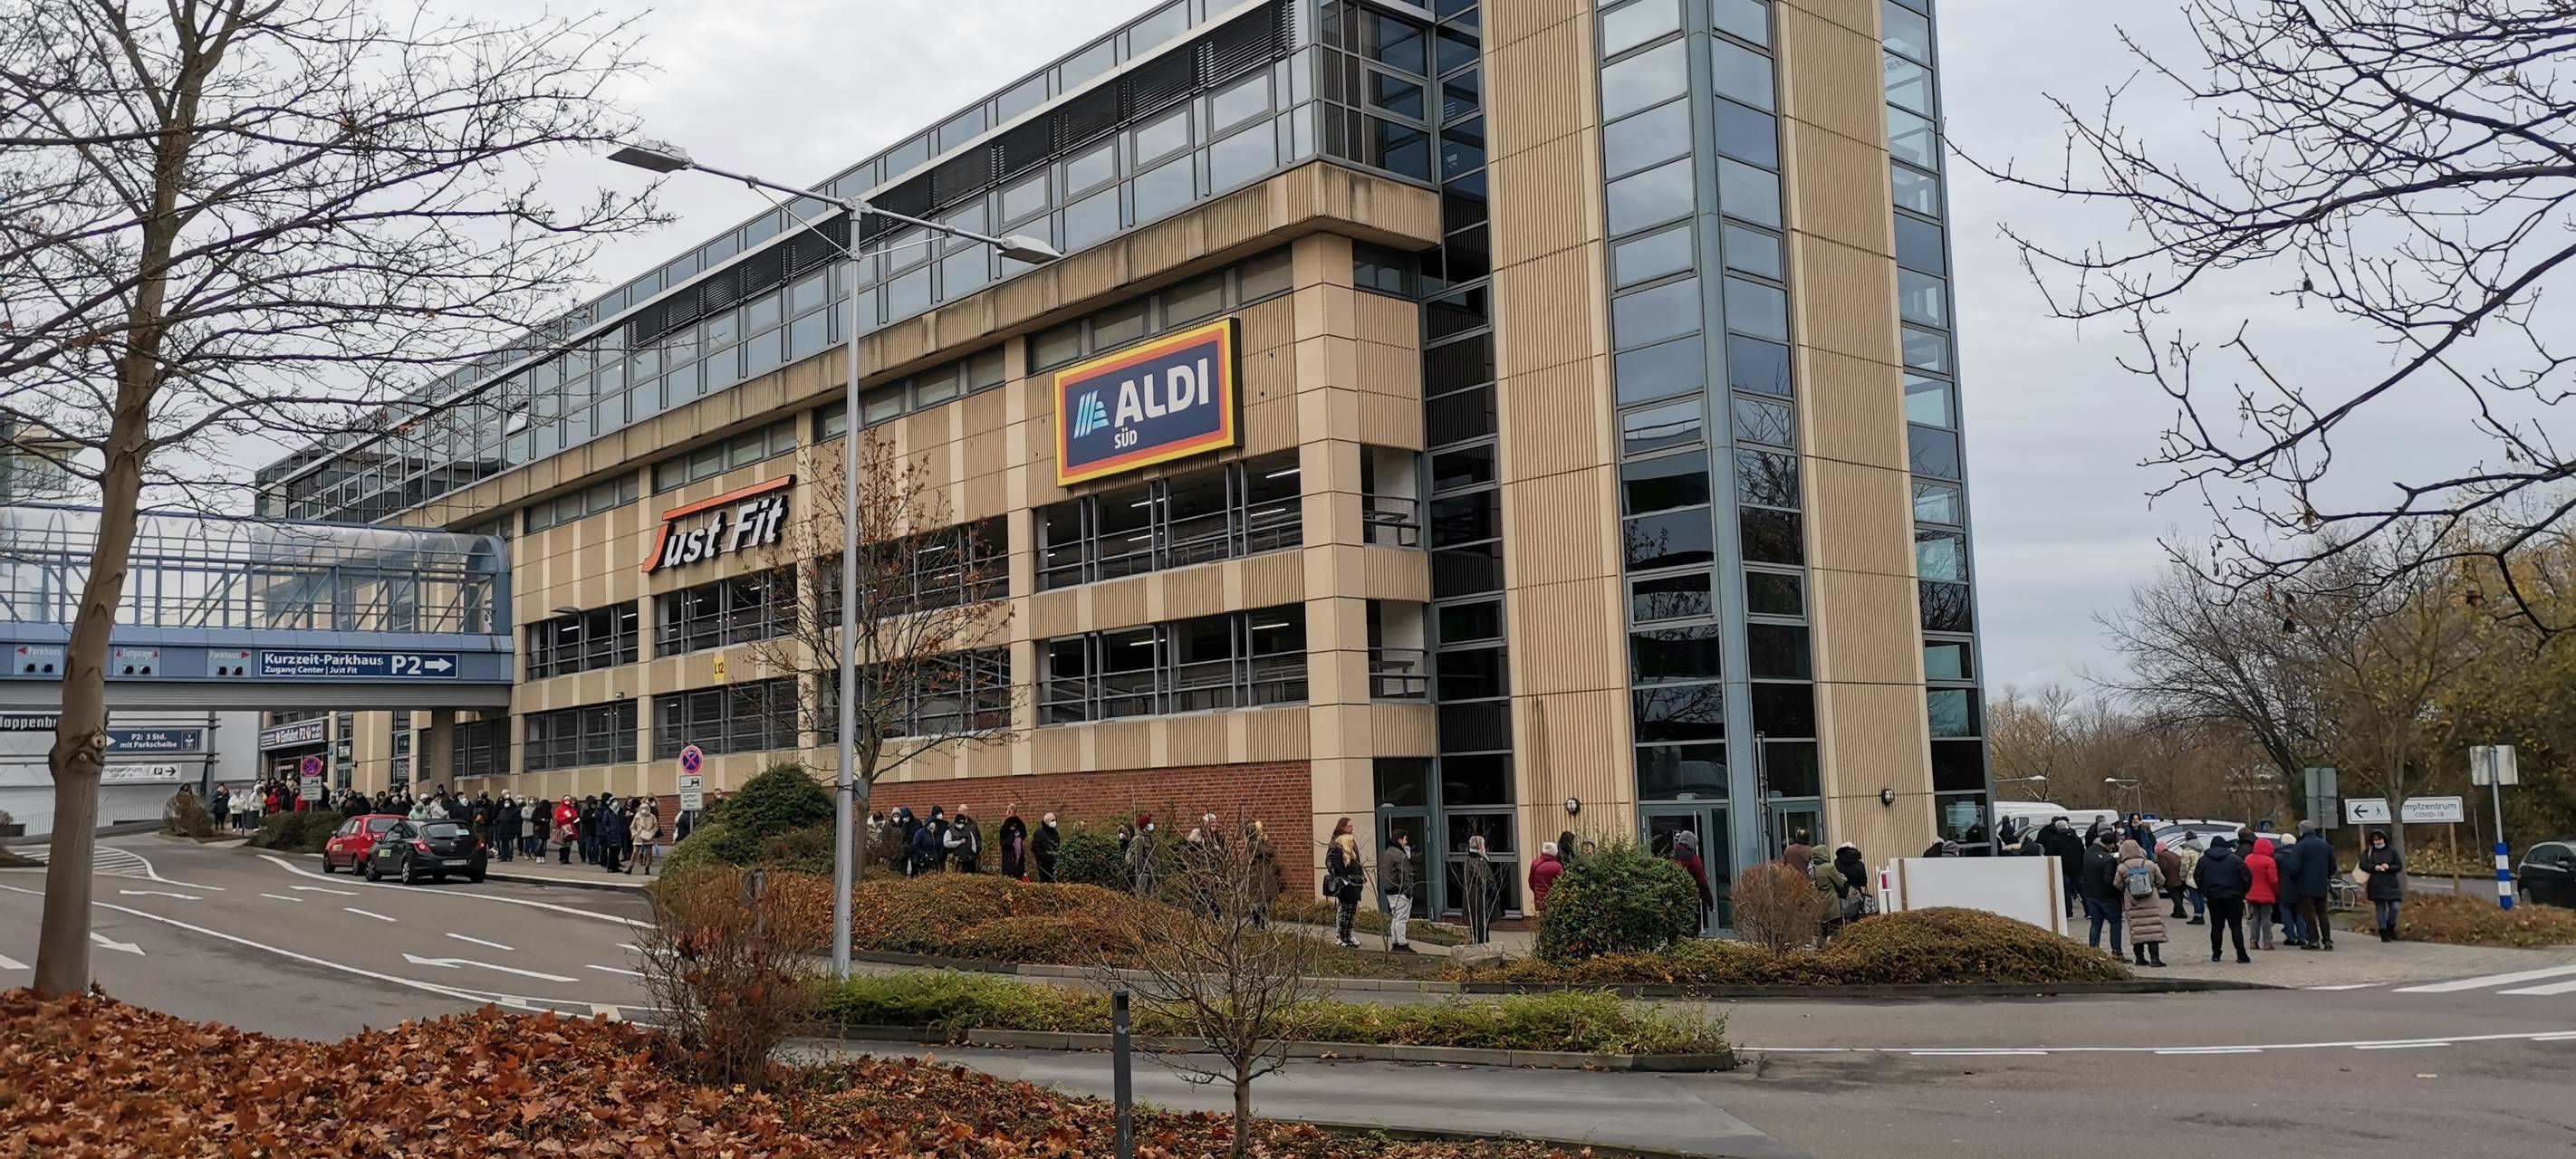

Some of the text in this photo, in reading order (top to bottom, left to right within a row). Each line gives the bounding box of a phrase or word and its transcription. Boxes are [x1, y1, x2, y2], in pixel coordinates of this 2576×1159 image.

[1114, 358, 1209, 427] ALDI
[1114, 427, 1138, 449] SÜD
[641, 496, 785, 572] Just Fit
[28, 646, 61, 656] Parkhaus
[122, 648, 153, 660] Tiefgarage
[209, 650, 239, 660] Parkhaus
[264, 653, 421, 675] Kurzzeit-Parkhaus P2
[264, 666, 296, 675] Zugang
[298, 666, 324, 674] Center
[330, 666, 345, 675] Just
[120, 741, 178, 749] mit Parkscheibe
[101, 766, 143, 774] mpfzentrum
[2402, 802, 2456, 811] mpfzentrum
